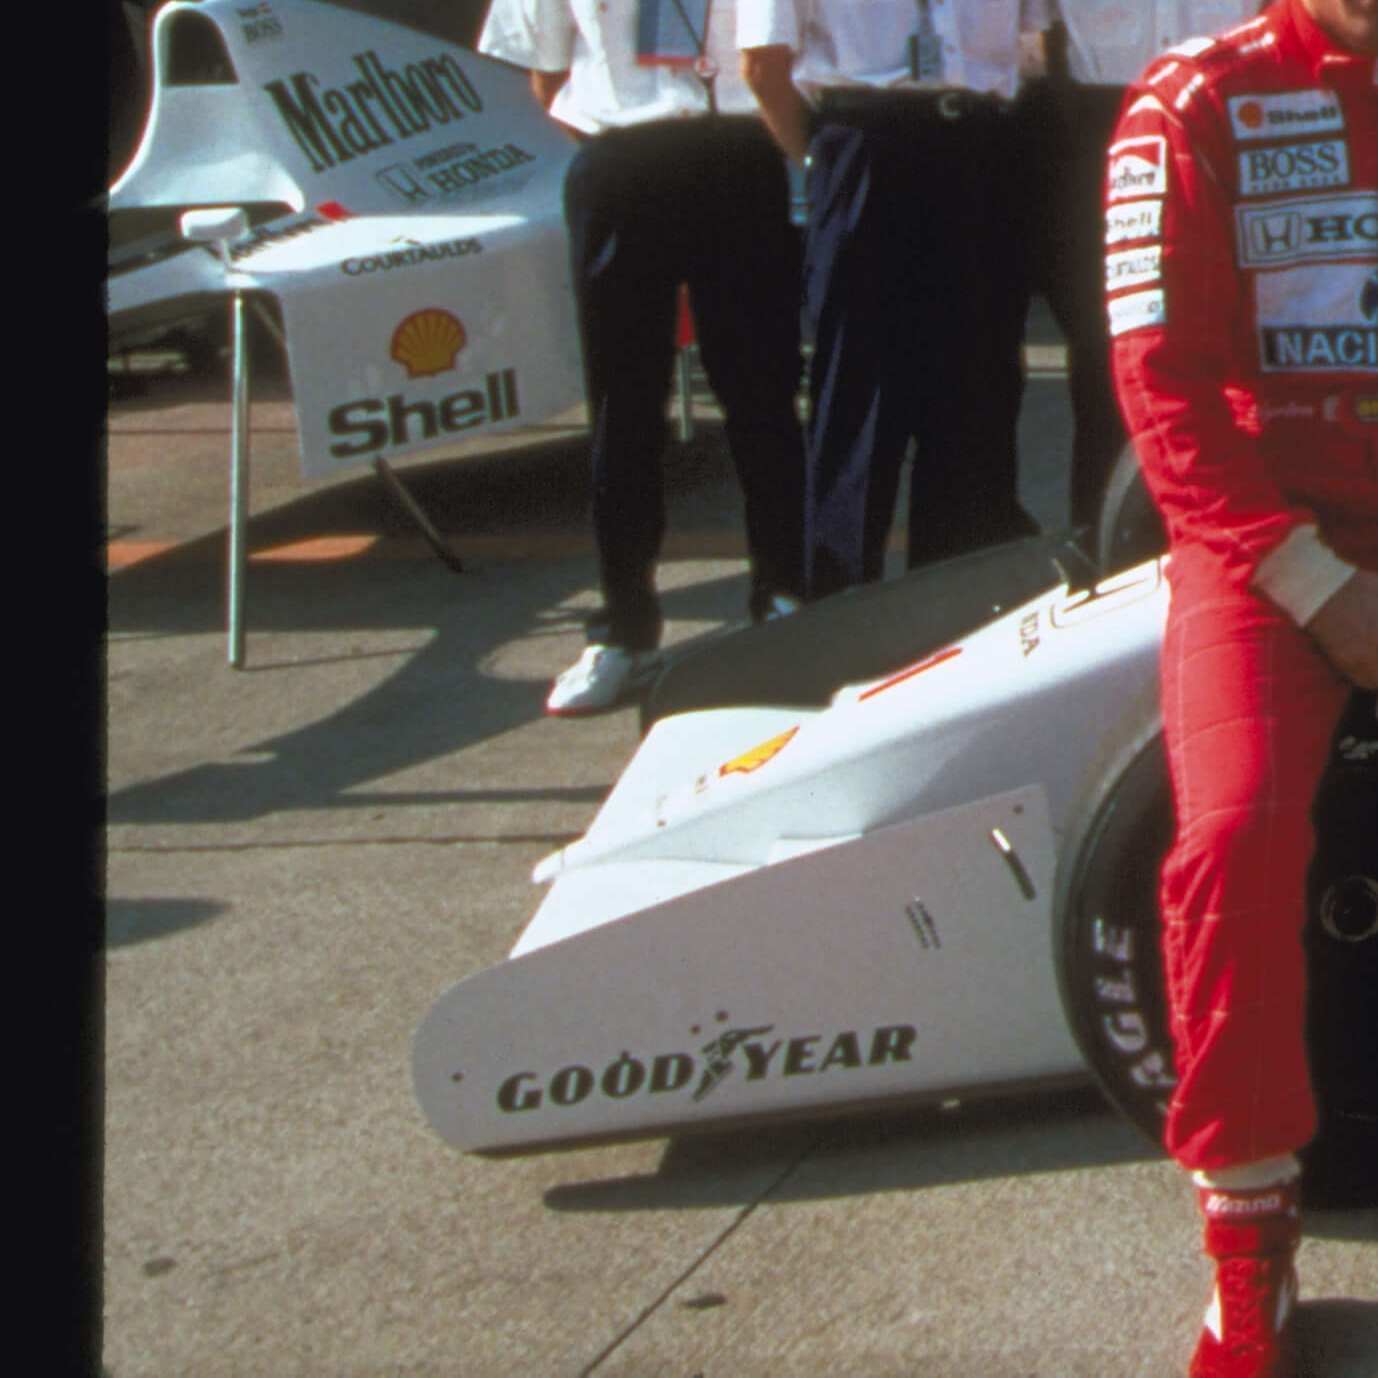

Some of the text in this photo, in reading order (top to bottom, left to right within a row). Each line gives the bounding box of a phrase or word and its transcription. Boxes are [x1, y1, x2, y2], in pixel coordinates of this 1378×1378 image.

[262, 49, 483, 175] Marlboro
[1266, 106, 1337, 124] Shell
[428, 143, 537, 194] HONDA
[1250, 144, 1340, 181] BOSS
[341, 237, 483, 276] COURTAULDS
[327, 367, 521, 461] Shell
[1094, 919, 1178, 1088] AGLE
